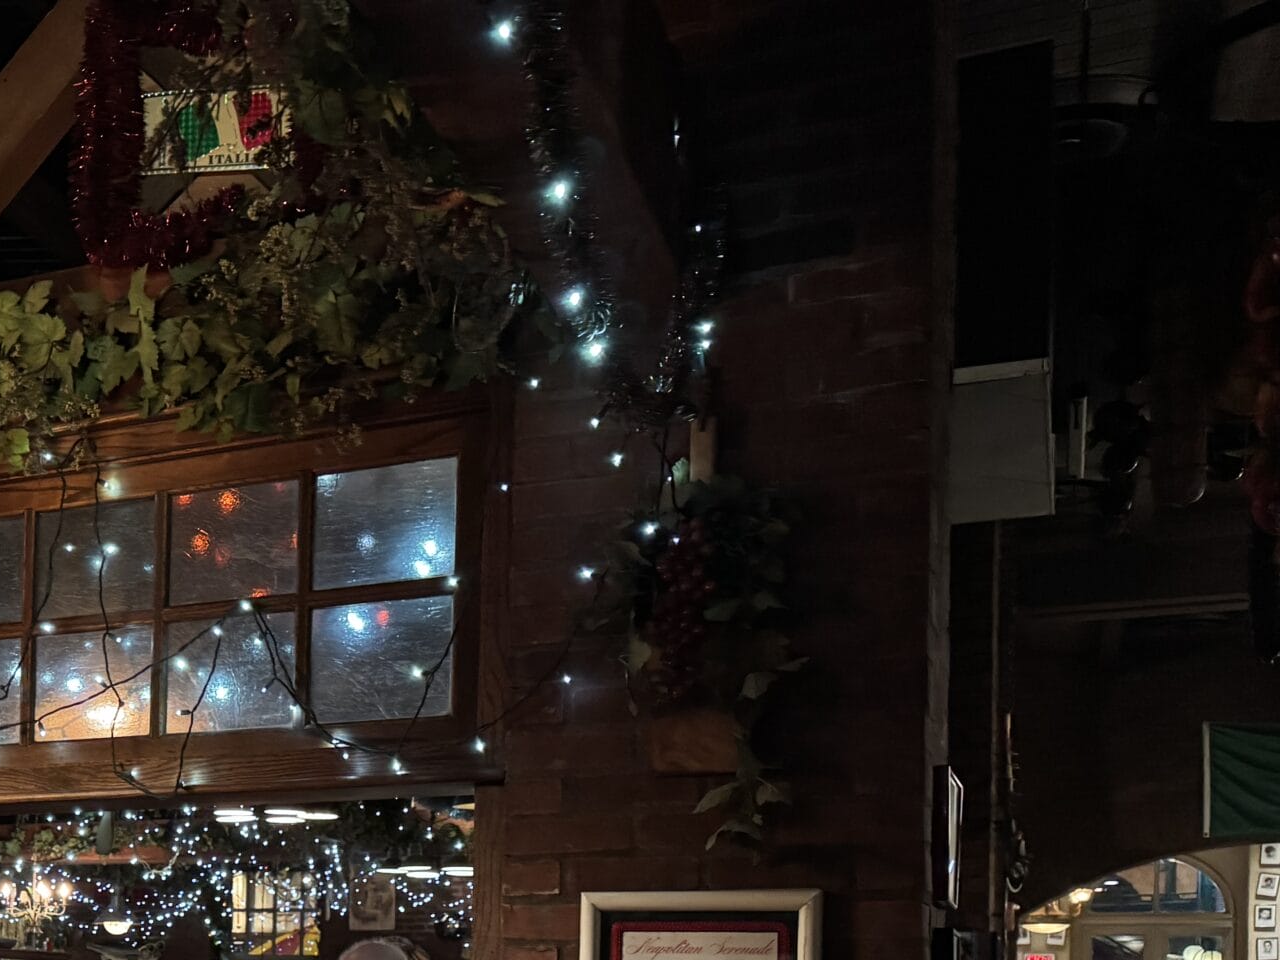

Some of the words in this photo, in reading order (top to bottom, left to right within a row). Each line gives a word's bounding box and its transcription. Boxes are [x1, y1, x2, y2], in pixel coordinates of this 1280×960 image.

[208, 153, 251, 164] ITALI
[626, 936, 703, 960] Neapolitan
[709, 936, 775, 956] Serenade
